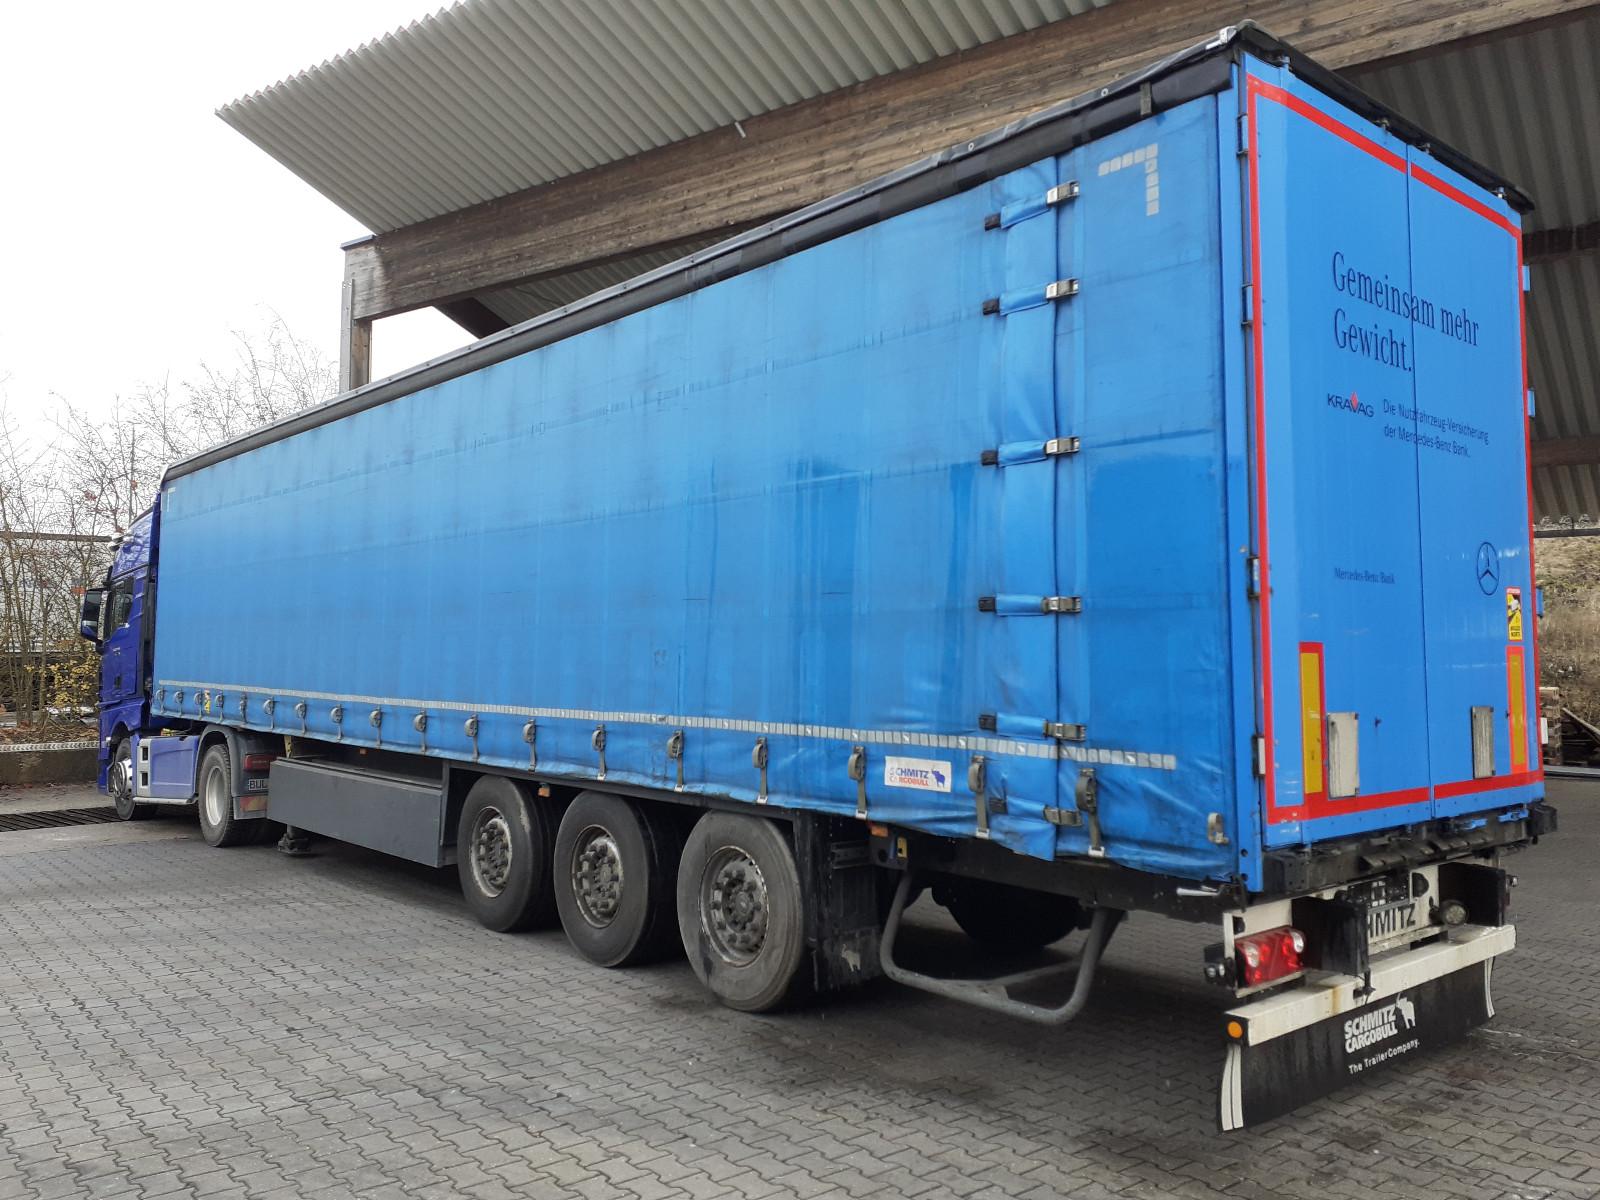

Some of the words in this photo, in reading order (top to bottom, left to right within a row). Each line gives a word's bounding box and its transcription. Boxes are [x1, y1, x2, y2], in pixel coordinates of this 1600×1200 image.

[1333, 251, 1435, 329] Gemeinsam
[1440, 307, 1479, 346] mehr
[1334, 308, 1412, 372] Gewicht.
[1327, 393, 1375, 418] KRAVAG
[1384, 399, 1396, 415] Die
[1384, 424, 1396, 438] der
[1398, 426, 1451, 452] Mercedes-Benz
[1344, 1004, 1396, 1040] SCHMITZ
[1345, 1021, 1398, 1053] CARGOBULL
[1348, 1063, 1363, 1075] The
